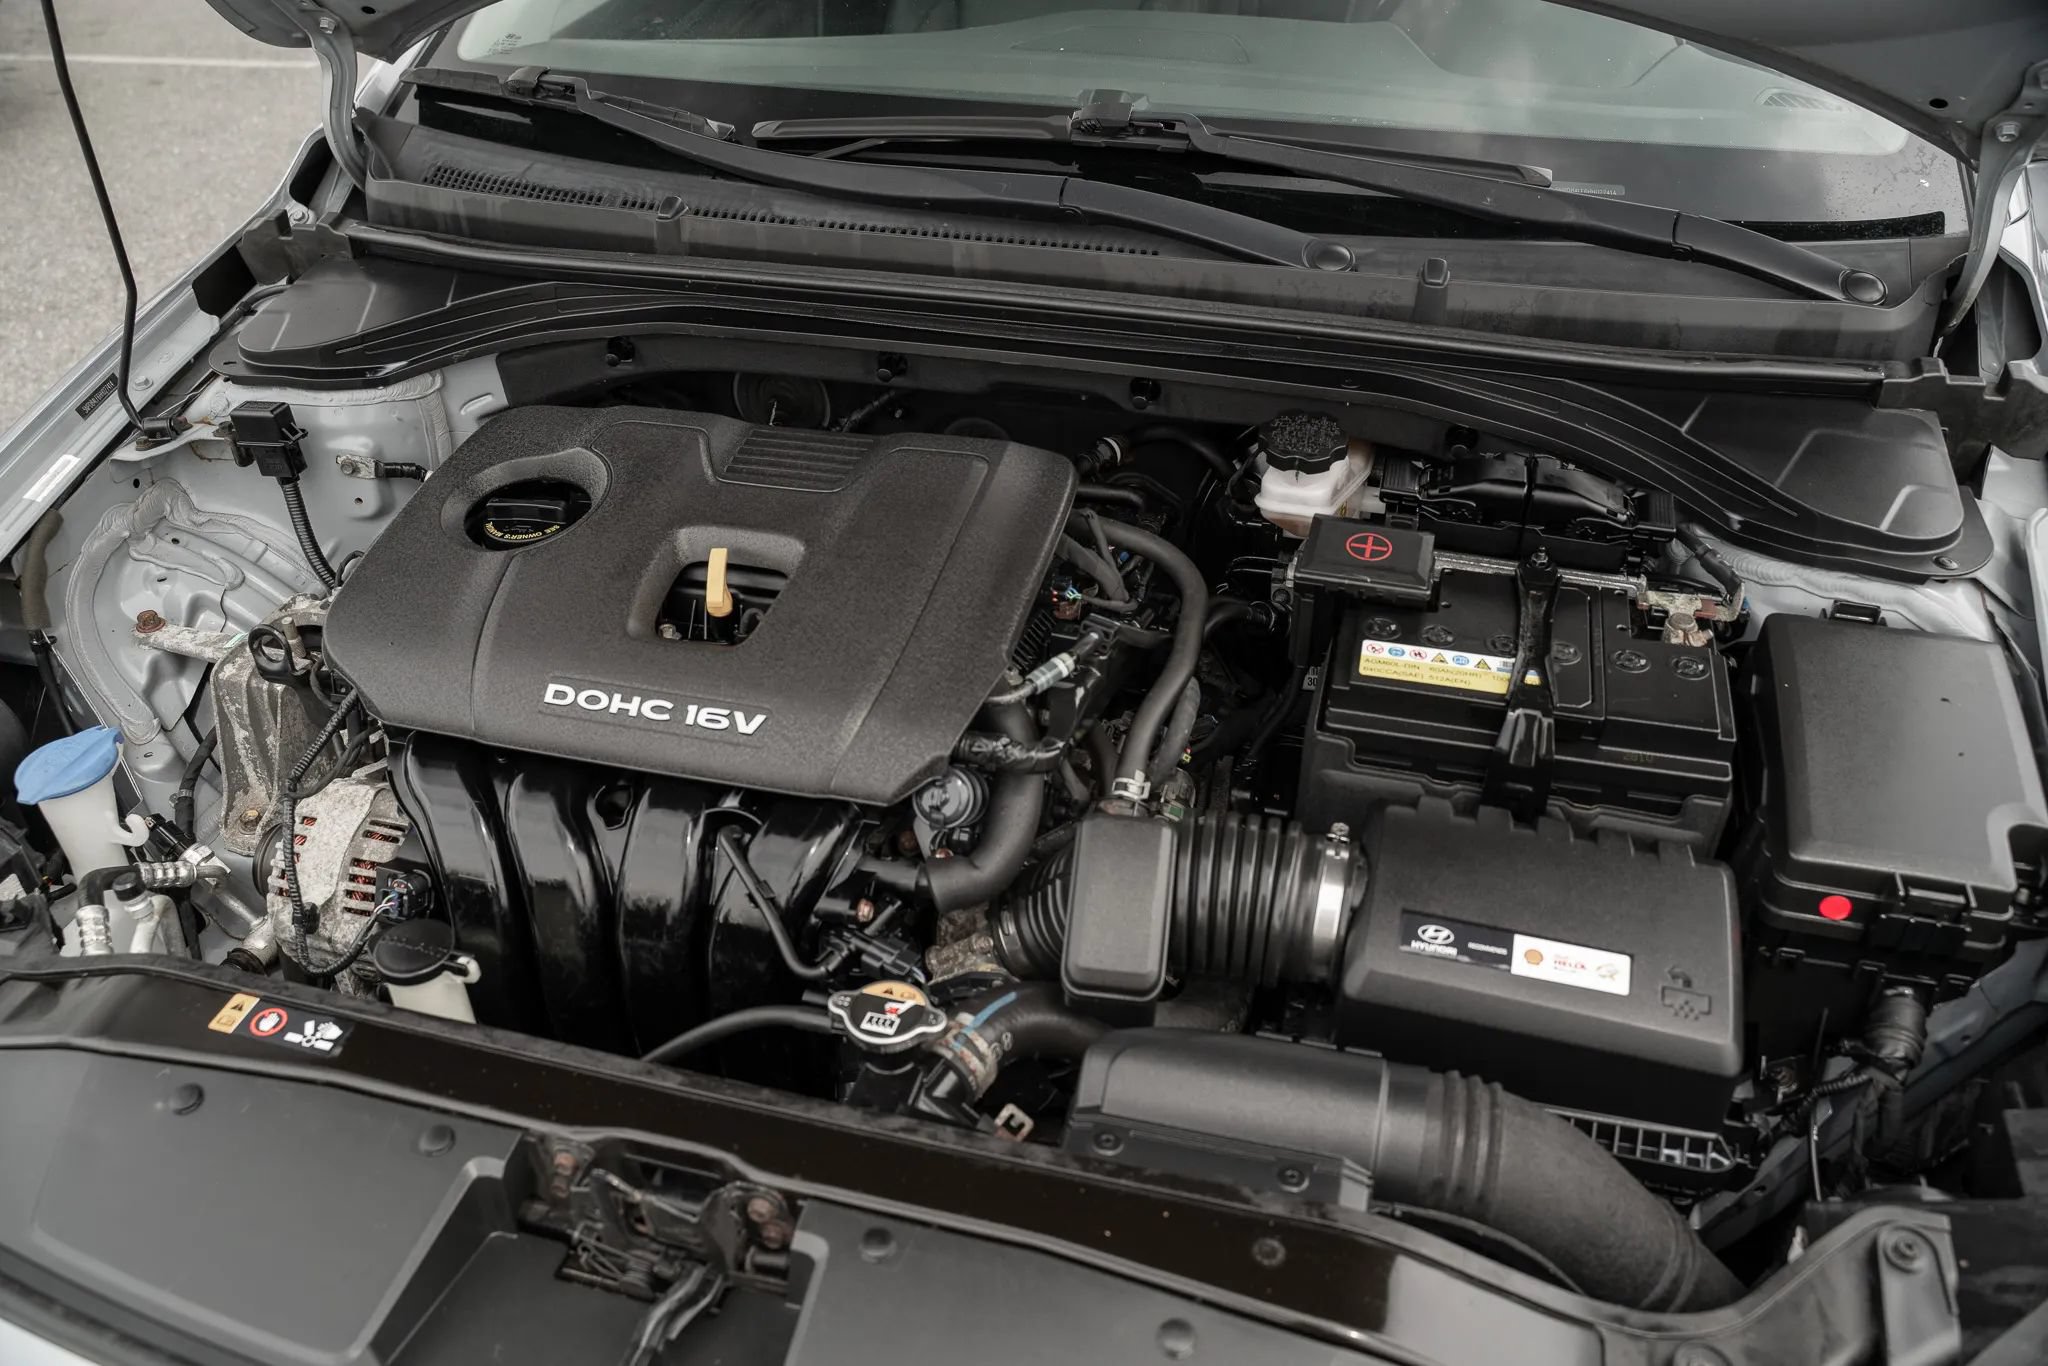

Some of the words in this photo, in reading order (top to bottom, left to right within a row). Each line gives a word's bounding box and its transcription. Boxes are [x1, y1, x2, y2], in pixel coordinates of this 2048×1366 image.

[503, 531, 543, 540] OWNER'S
[544, 525, 560, 534] SEE
[544, 683, 674, 721] DOHC
[685, 704, 767, 735] 16V
[1410, 939, 1458, 956] HYUNDAI
